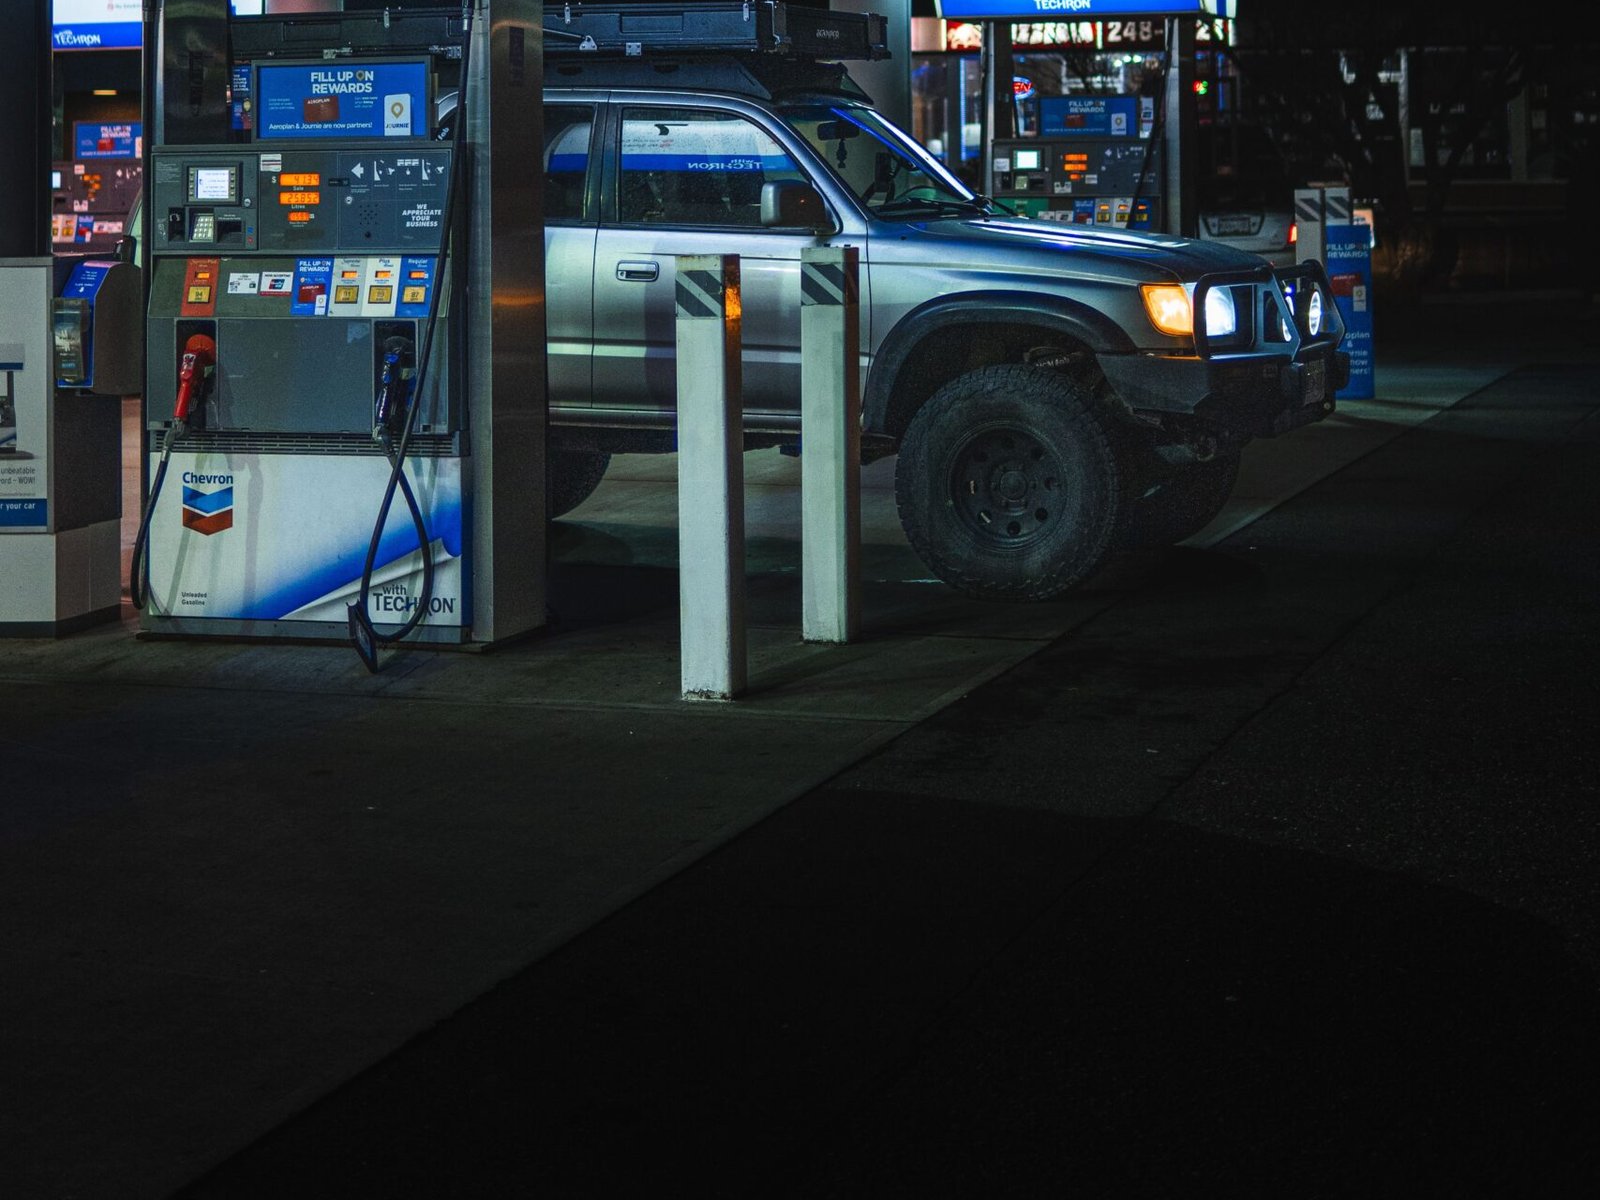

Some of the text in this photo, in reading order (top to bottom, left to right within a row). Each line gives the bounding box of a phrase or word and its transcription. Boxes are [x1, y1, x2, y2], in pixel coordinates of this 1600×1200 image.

[54, 31, 101, 46] TECHRON
[311, 71, 336, 83] FILL
[337, 71, 353, 82] UP
[312, 83, 373, 94] REWARDS
[1328, 251, 1369, 259] REWARDS
[1345, 331, 1370, 339] oplan
[182, 471, 234, 485] Chevron
[6, 503, 21, 511] your
[382, 584, 407, 596] with
[373, 593, 456, 616] TECHON
